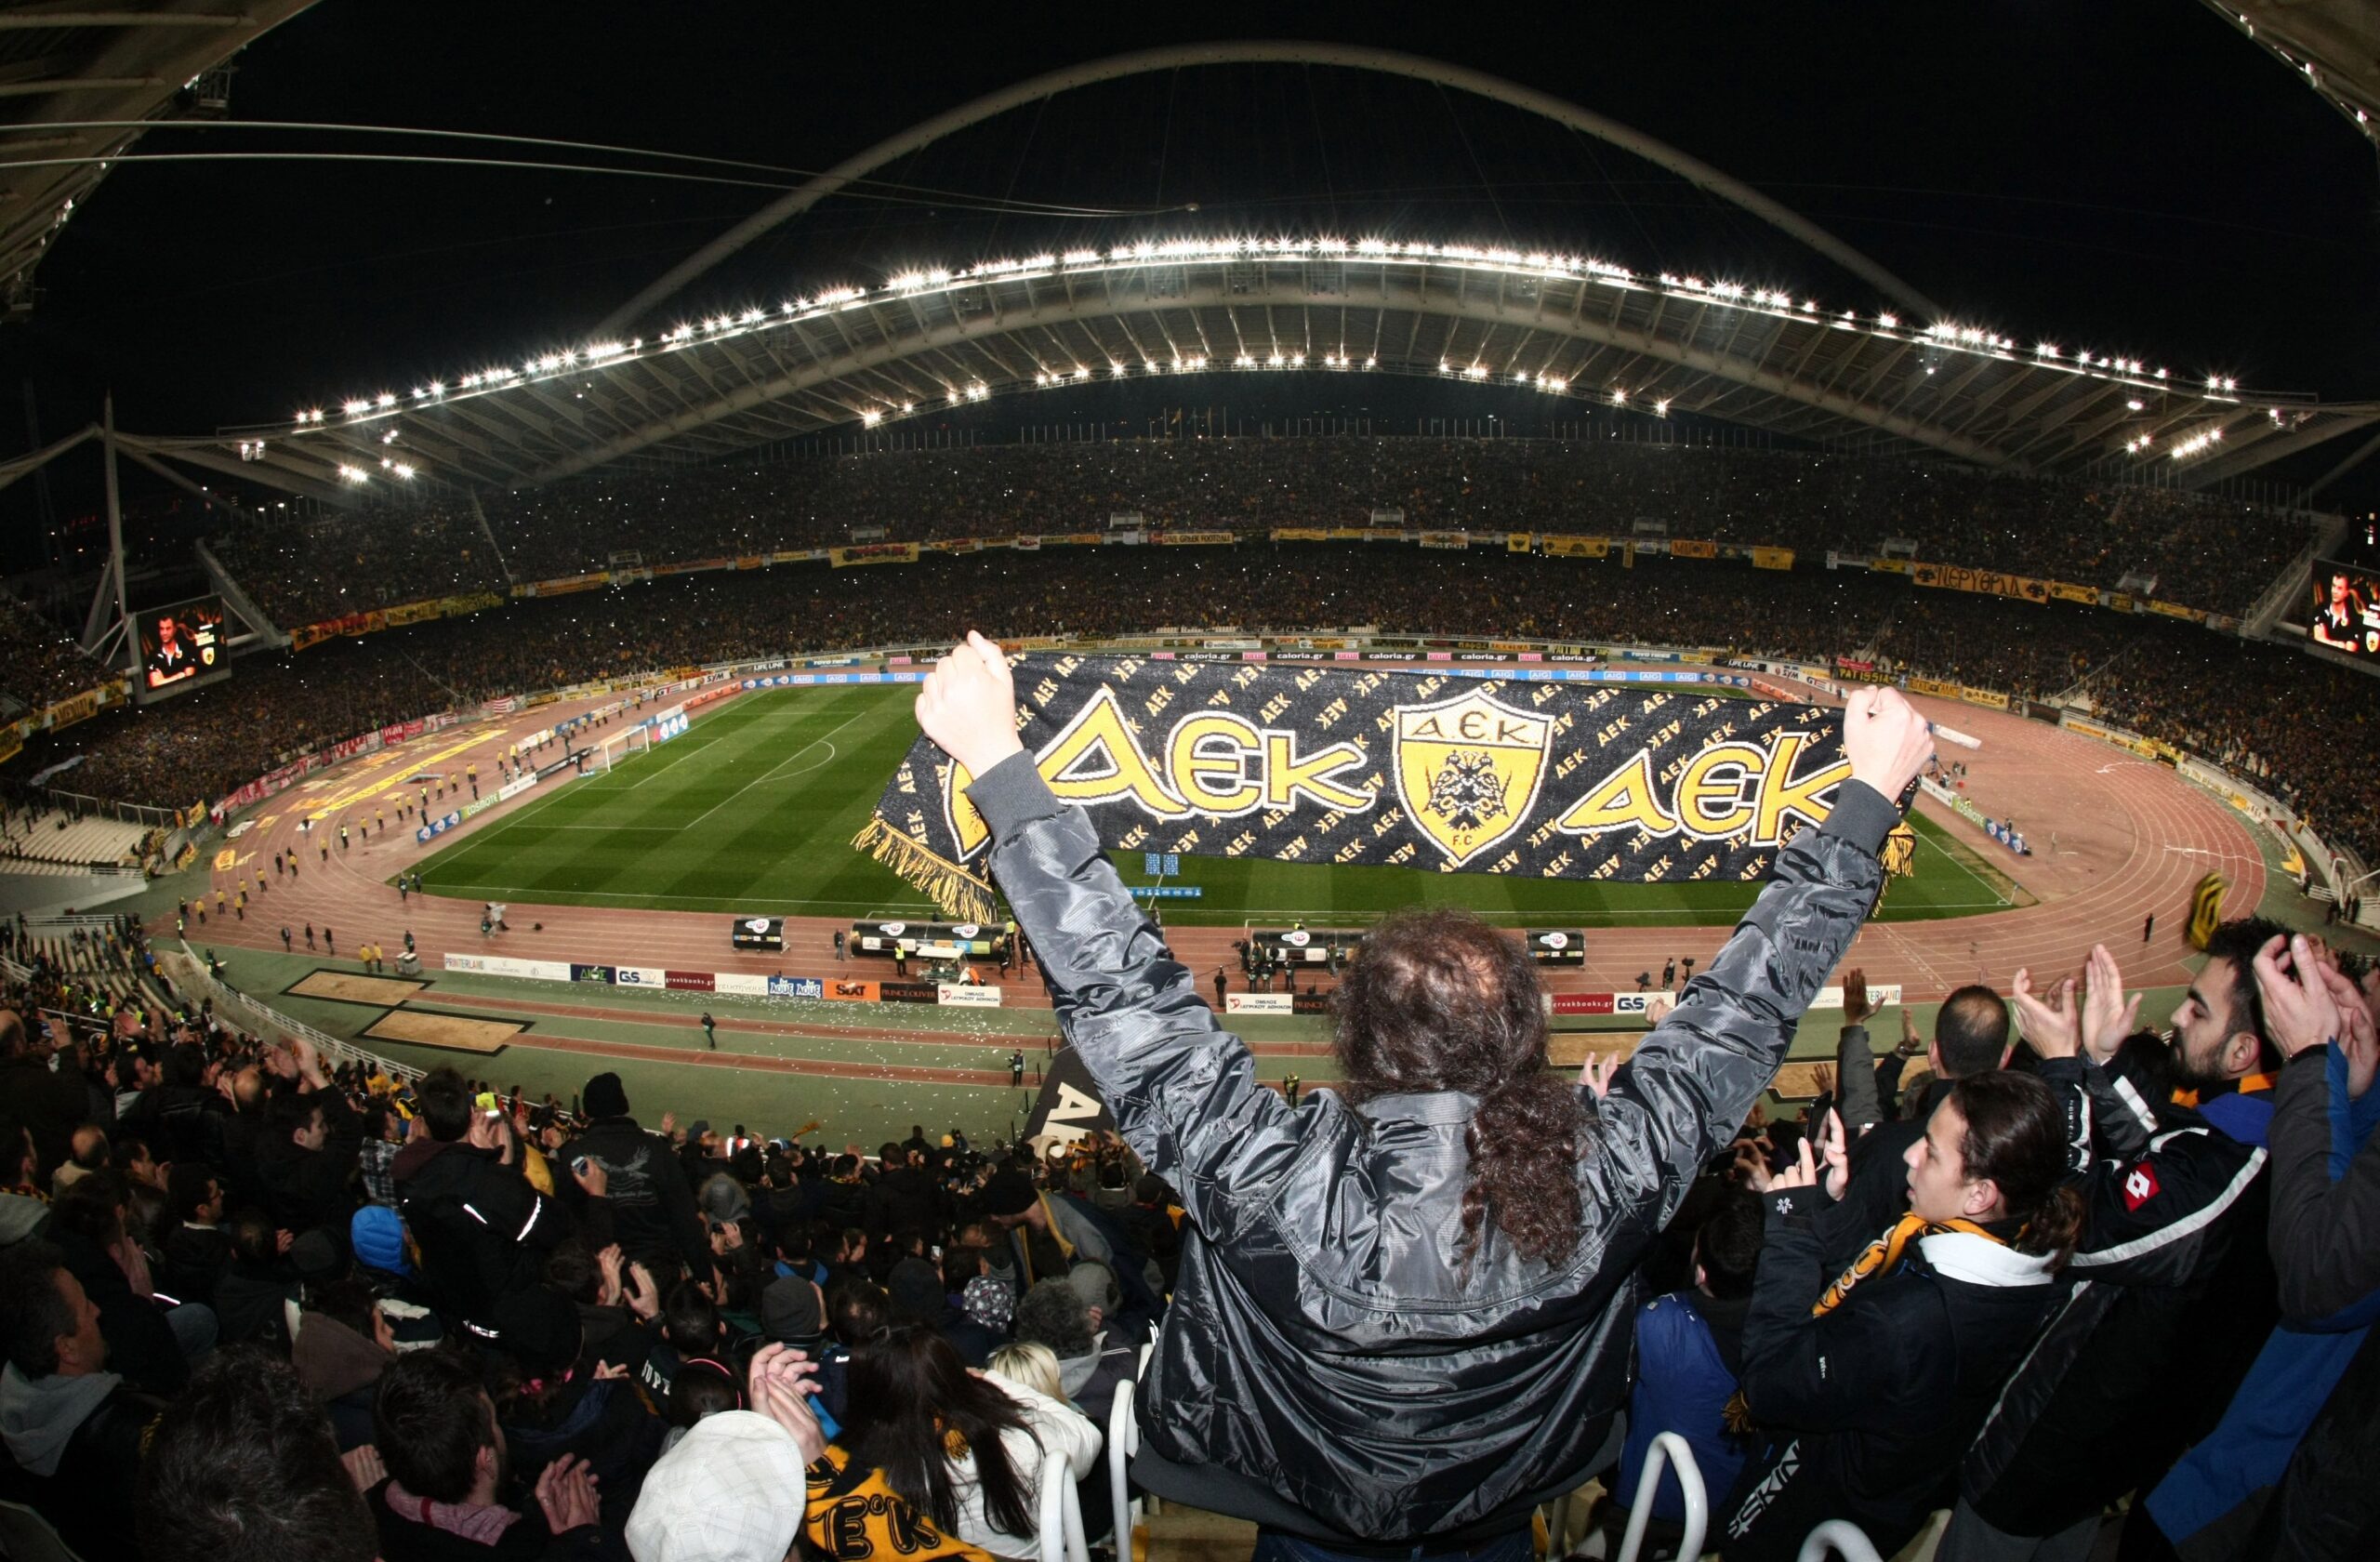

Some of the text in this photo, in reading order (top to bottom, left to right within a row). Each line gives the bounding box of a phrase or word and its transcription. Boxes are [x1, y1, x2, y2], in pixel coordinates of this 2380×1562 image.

[1839, 668, 1890, 683] PATISSIA
[1032, 677, 1059, 708] AEK
[1144, 685, 1175, 718] AEK
[1259, 693, 1292, 724] AEK
[1315, 697, 1348, 731] AEK
[1597, 714, 1631, 748] AEK
[1647, 720, 1681, 749] AEK
[1554, 748, 1588, 779] AEK
[467, 793, 498, 815] COSMOTE
[1371, 807, 1404, 837] AEK
[1333, 838, 1367, 863] AEK
[1542, 852, 1573, 878] AEK
[1644, 854, 1673, 883] AEK
[1739, 855, 1768, 881] AEK
[446, 958, 483, 970] PRINTERLAND
